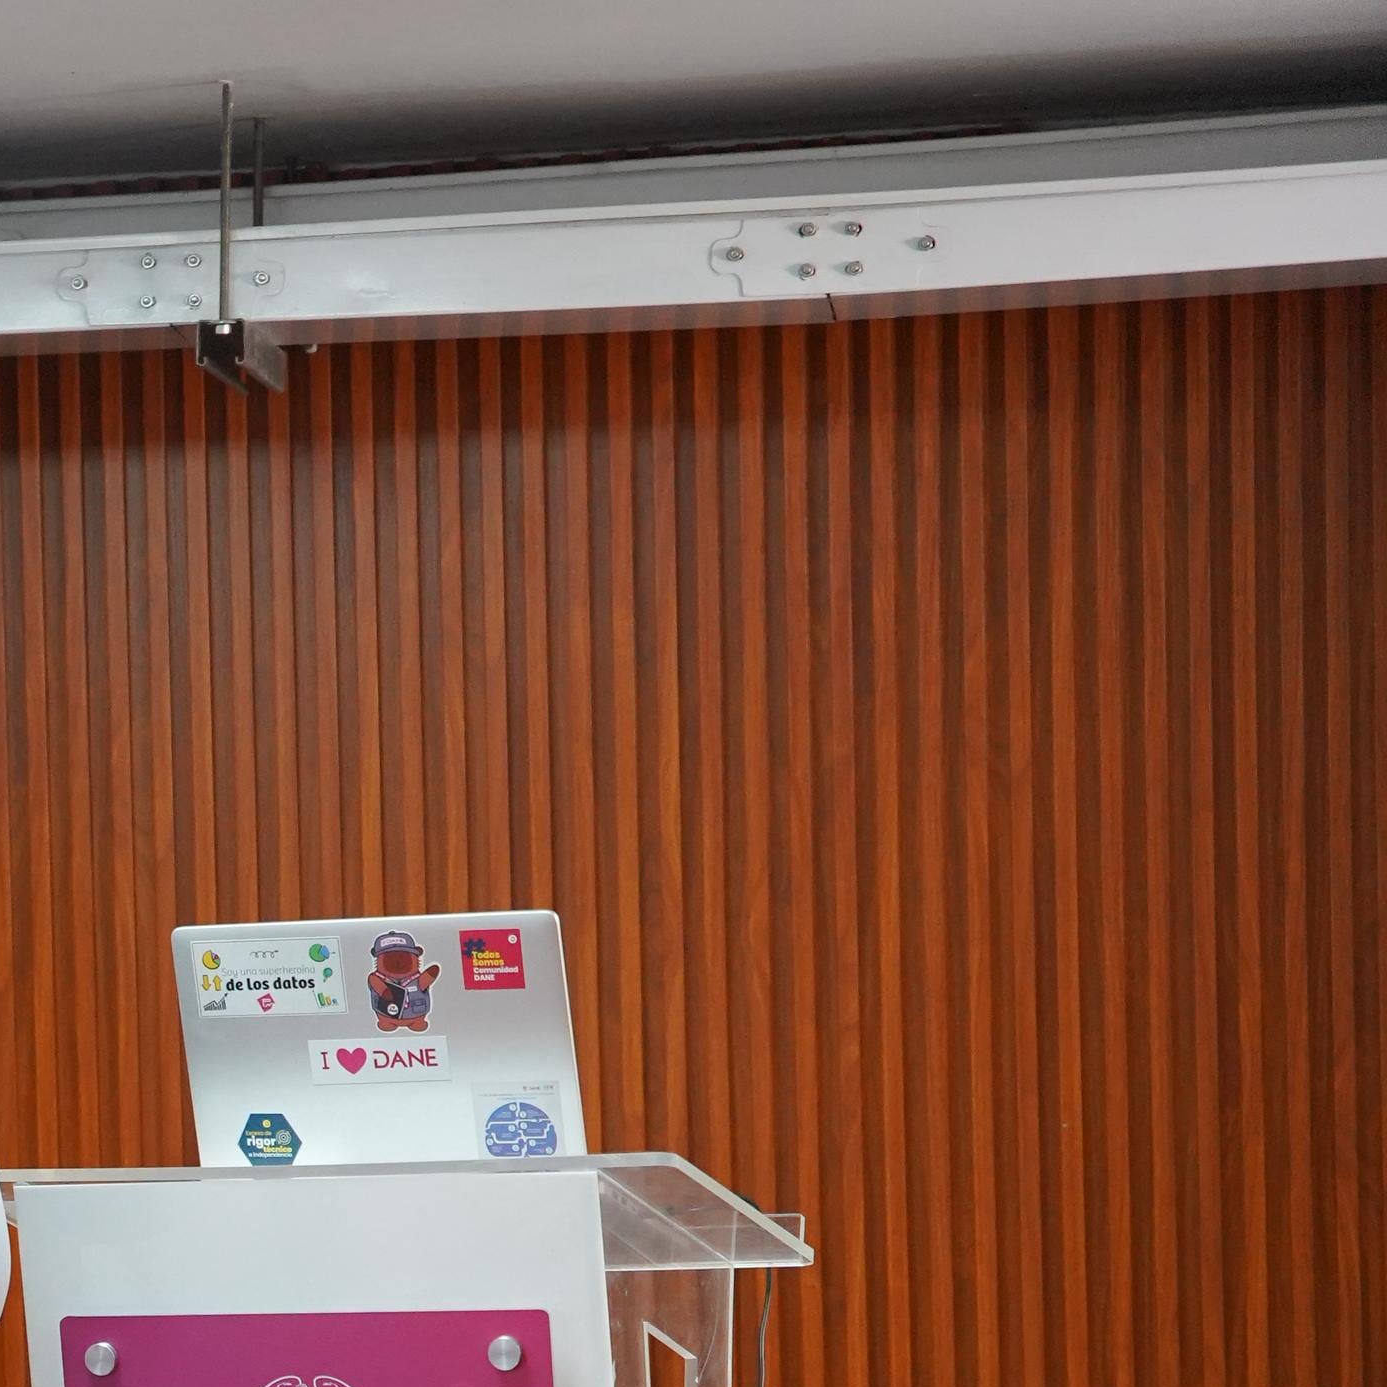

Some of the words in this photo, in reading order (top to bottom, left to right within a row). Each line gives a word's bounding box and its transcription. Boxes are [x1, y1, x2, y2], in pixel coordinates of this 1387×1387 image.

[226, 979, 244, 991] de
[246, 977, 270, 991] los
[273, 976, 316, 990] datos
[320, 1051, 330, 1070] I
[372, 1048, 439, 1069] DANE
[247, 1135, 276, 1149] rigor
